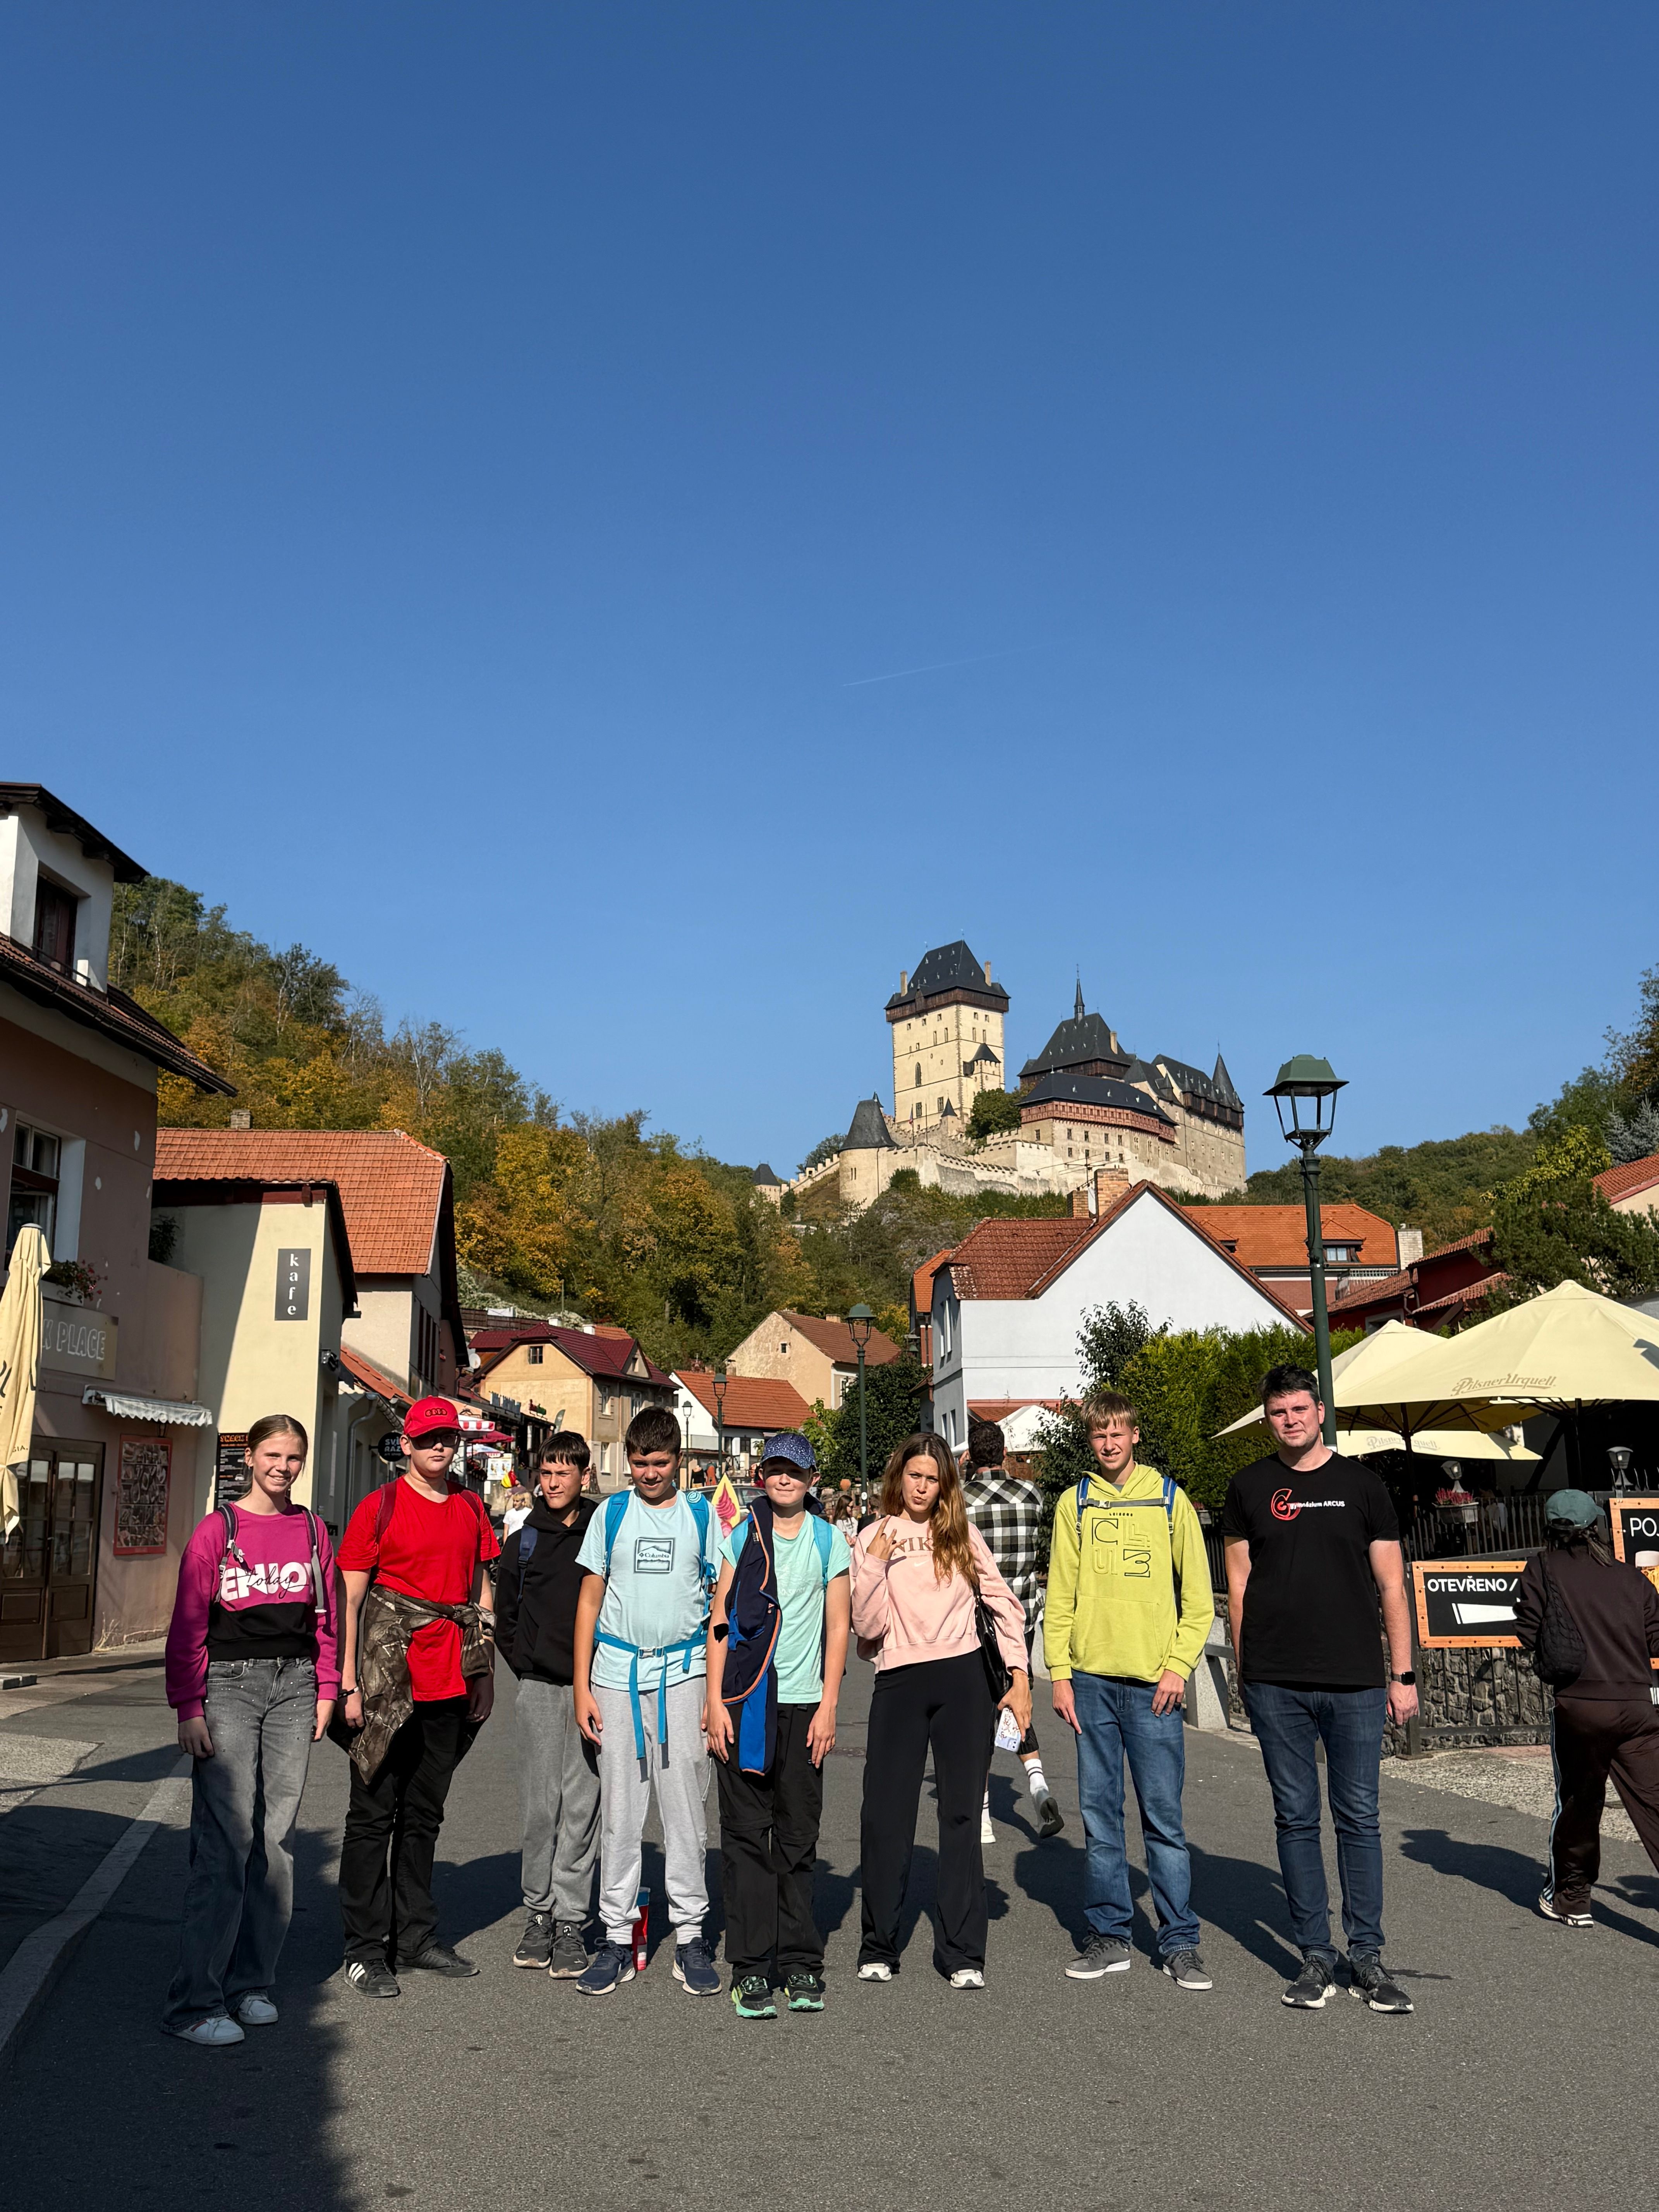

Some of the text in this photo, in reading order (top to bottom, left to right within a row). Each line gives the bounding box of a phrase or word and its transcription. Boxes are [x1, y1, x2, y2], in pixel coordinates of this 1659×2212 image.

[287, 1254, 299, 1315] kafe
[57, 1322, 106, 1360] PLACE
[1451, 1373, 1556, 1396] Pilsner Urquell
[1630, 1517, 1659, 1537] PO
[228, 1566, 309, 1599] today
[1427, 1576, 1507, 1592] OTEVŘENO
